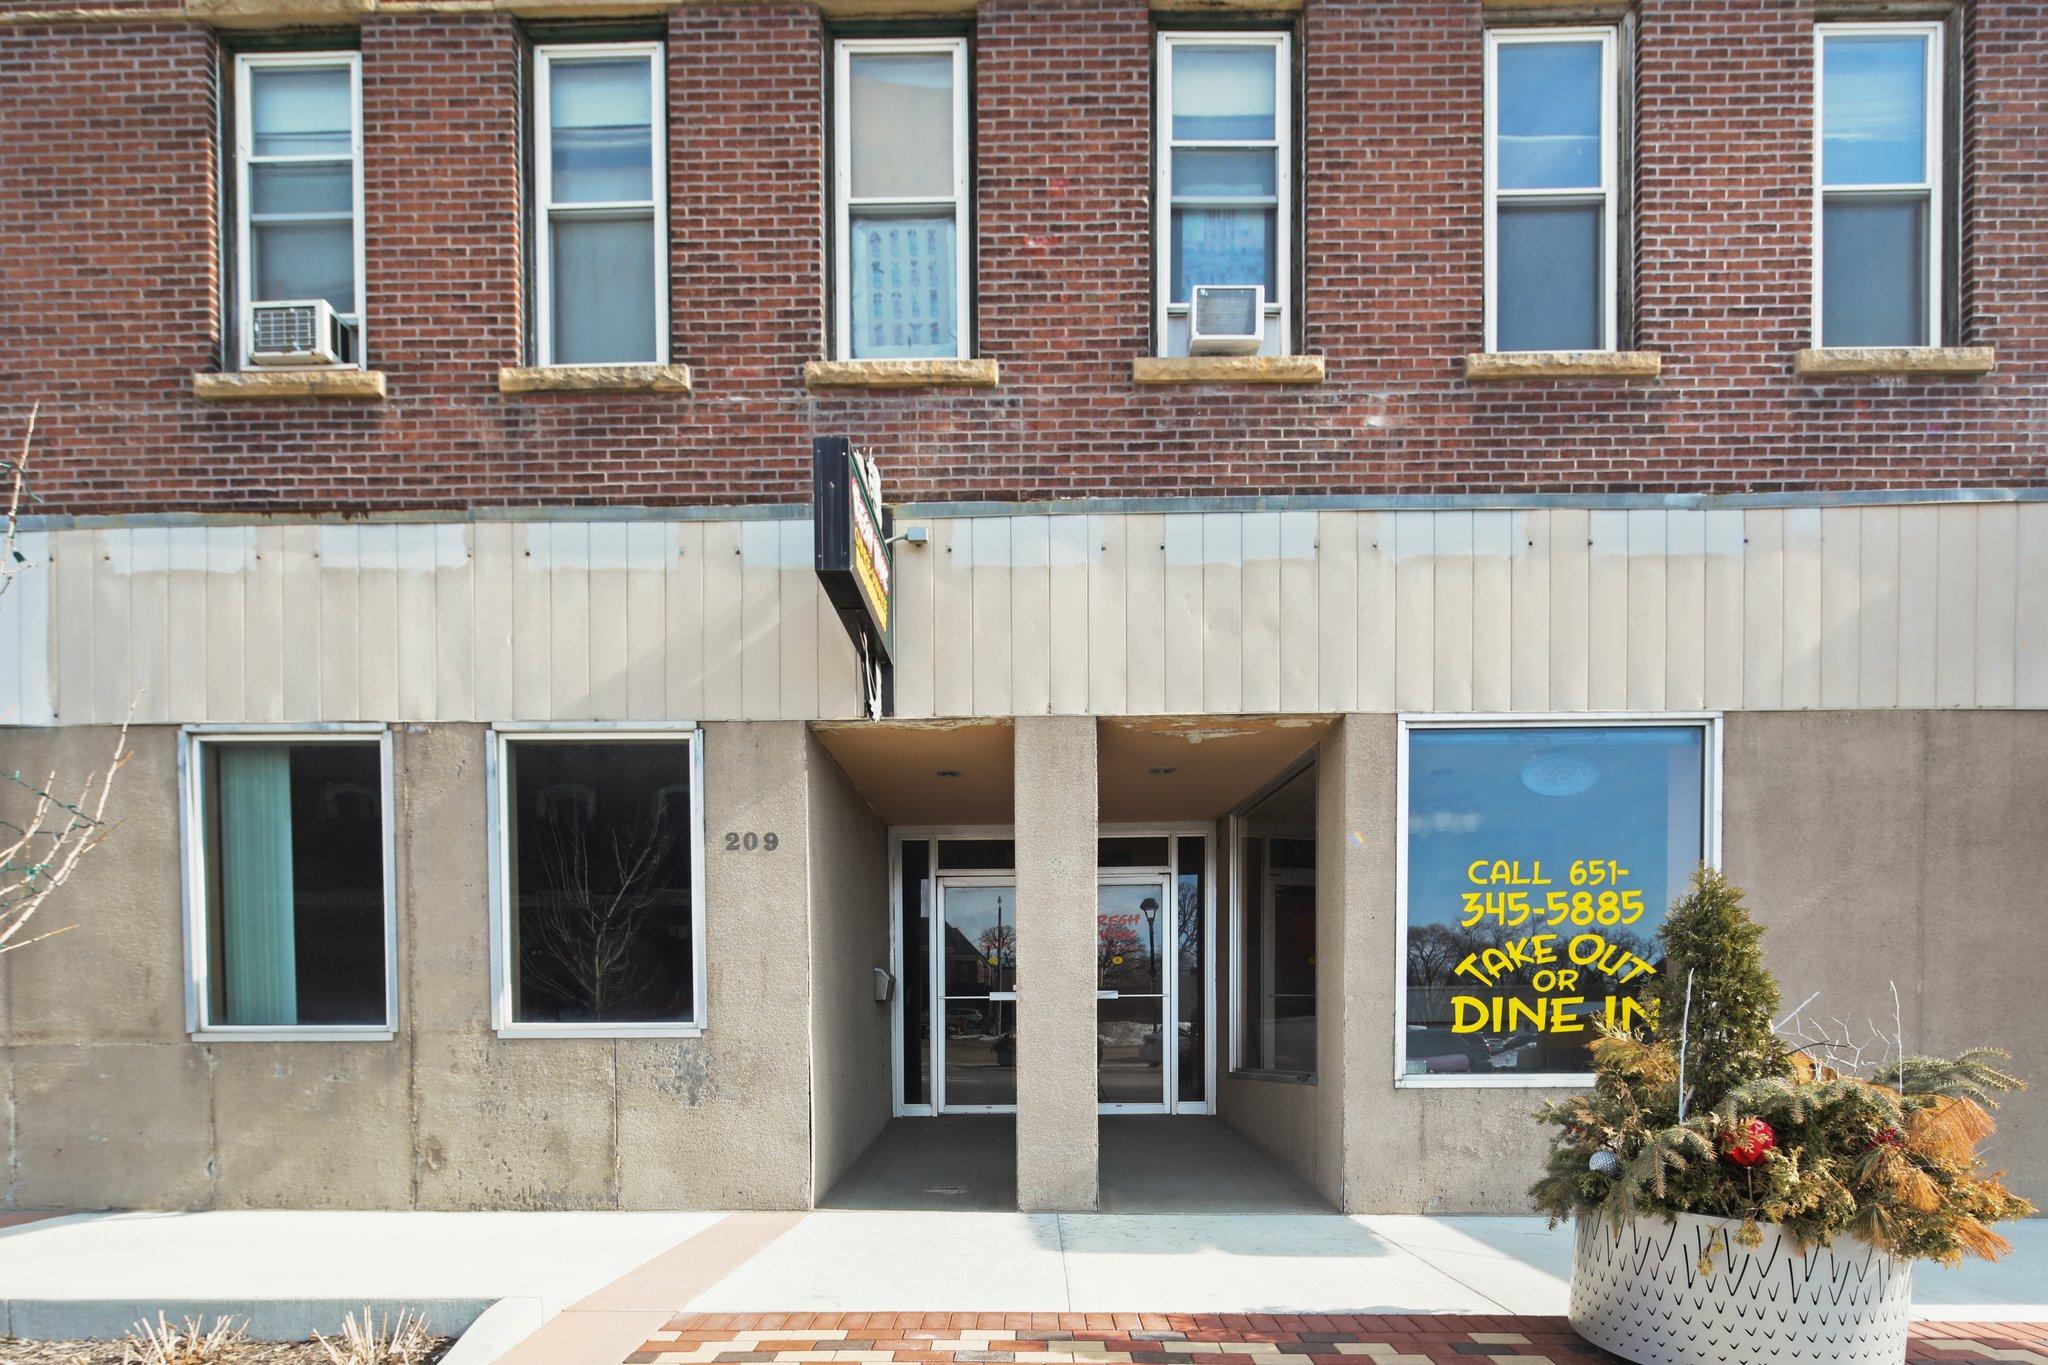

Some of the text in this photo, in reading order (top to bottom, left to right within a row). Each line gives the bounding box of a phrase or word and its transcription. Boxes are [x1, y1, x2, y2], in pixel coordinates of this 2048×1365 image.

[1531, 767, 1592, 783] OPEN
[725, 831, 779, 851] 209
[1467, 860, 1629, 886] CALL 651-
[1097, 913, 1141, 925] RESH
[1461, 890, 1644, 927] 345-5885
[1454, 934, 1657, 987] TAKE OUT
[1532, 969, 1579, 992] OR
[1451, 996, 1660, 1033] DINE IN
